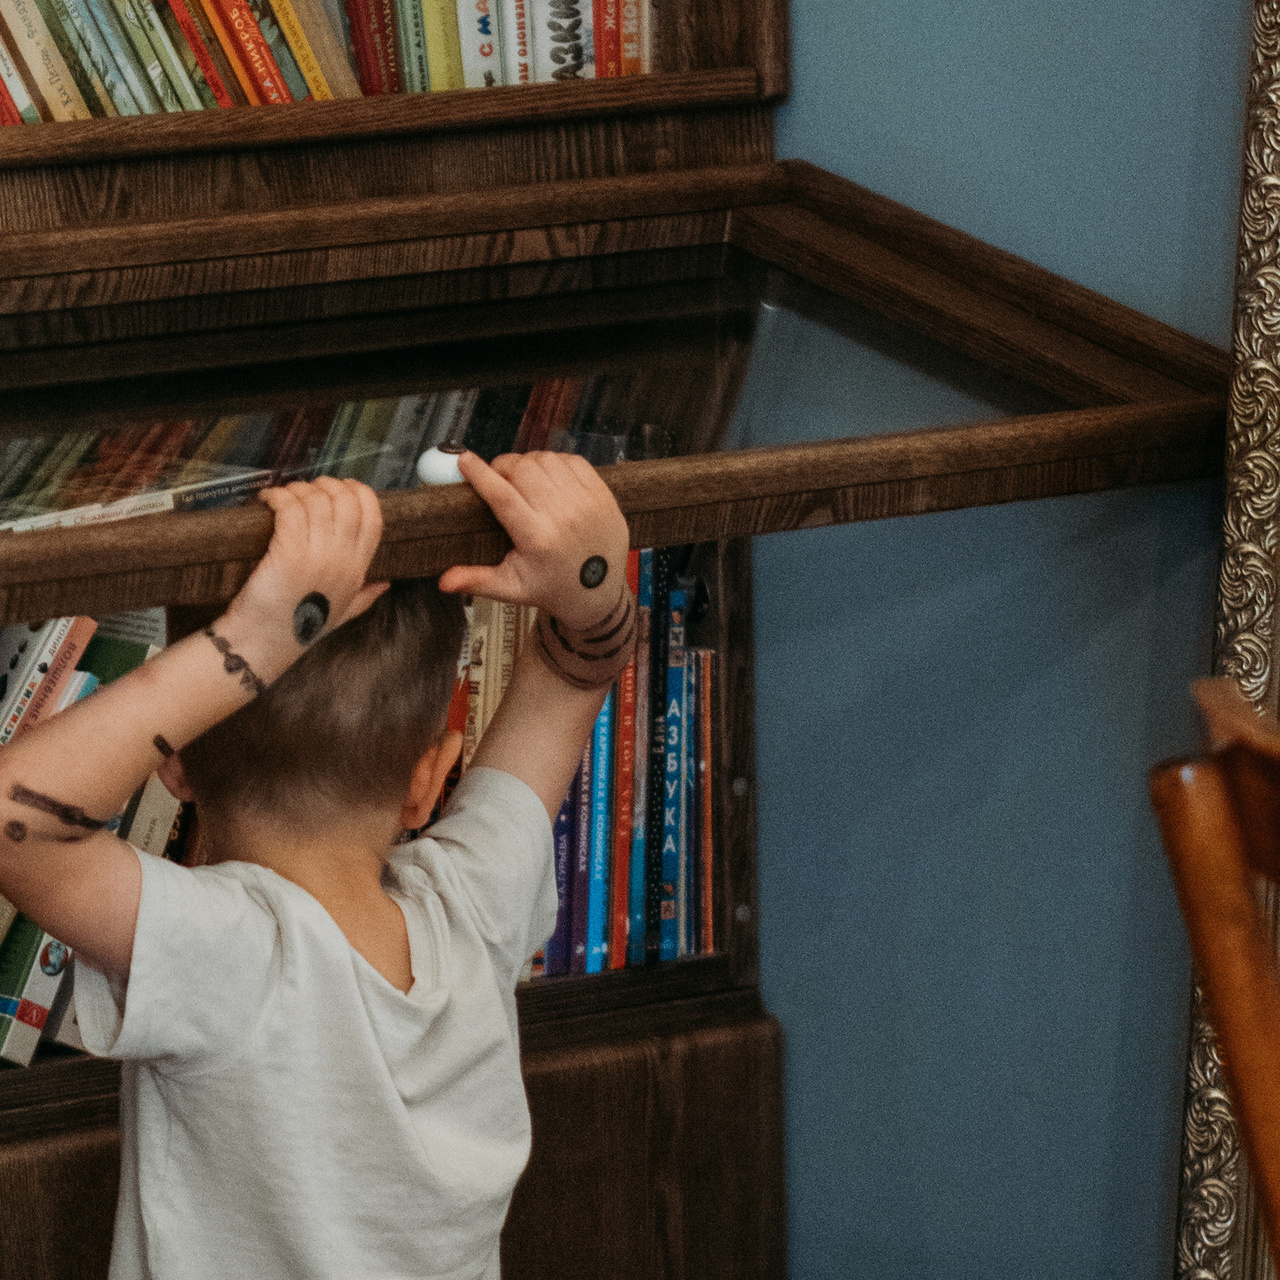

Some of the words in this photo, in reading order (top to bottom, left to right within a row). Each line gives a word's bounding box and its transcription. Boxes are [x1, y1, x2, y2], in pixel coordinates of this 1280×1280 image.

[591, 725, 615, 799] КАРТИНКАХ
[661, 698, 681, 854] АЗБУКА
[572, 804, 593, 873] КОМИКСАХ
[596, 802, 607, 811] И
[588, 813, 609, 881] КОМИКСАХ
